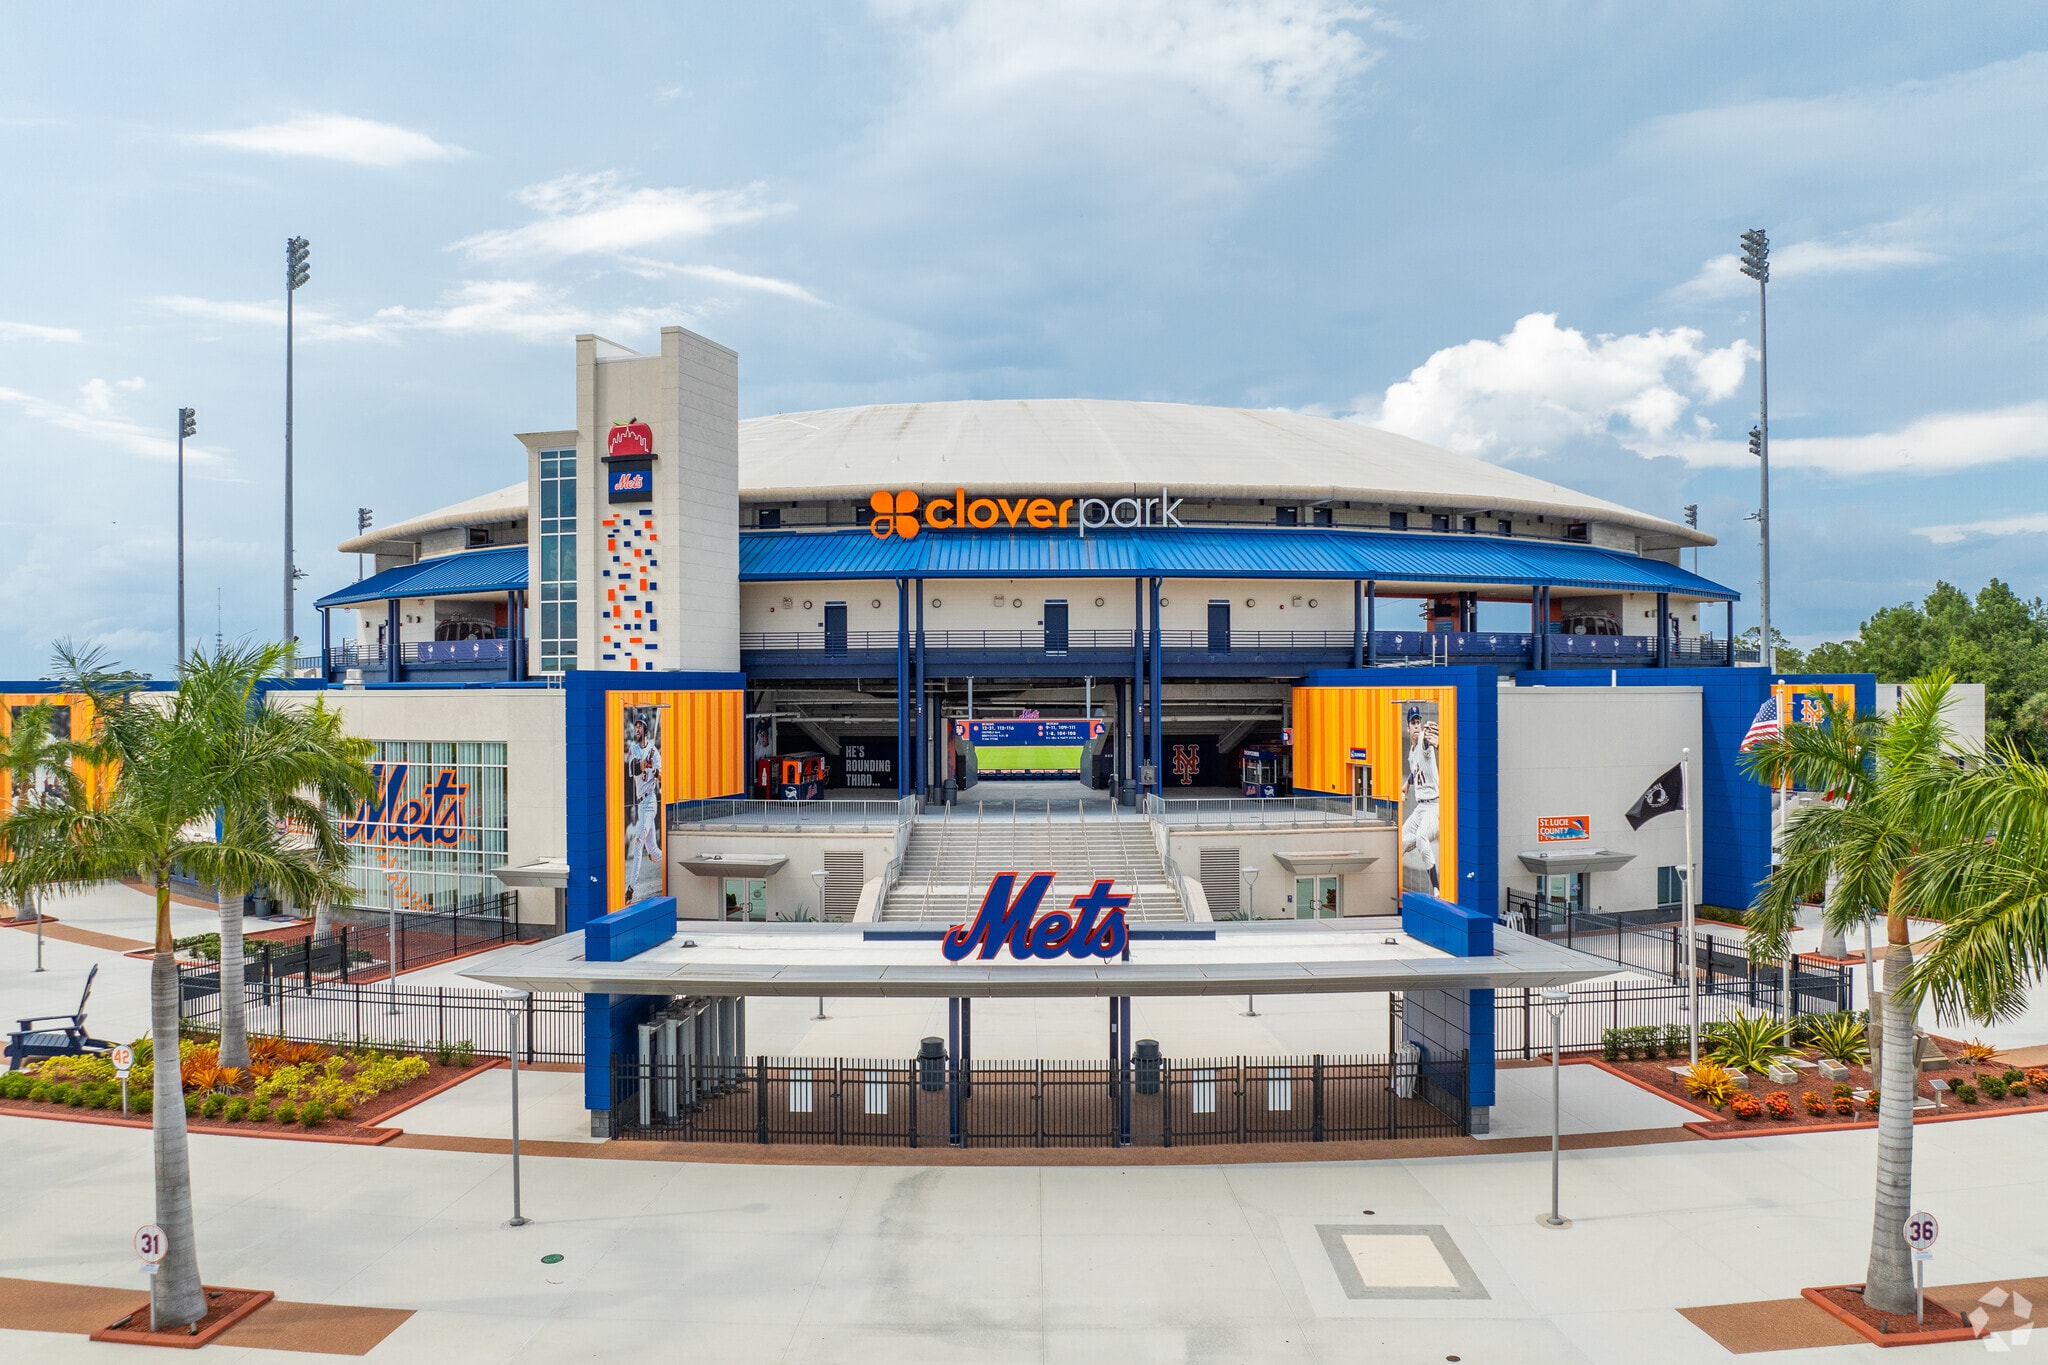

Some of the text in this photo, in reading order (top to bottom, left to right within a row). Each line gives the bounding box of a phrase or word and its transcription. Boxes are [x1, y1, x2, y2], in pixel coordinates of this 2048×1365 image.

[614, 473, 644, 491] Mets
[924, 487, 1185, 538] clover park
[846, 745, 865, 758] HE'S
[846, 759, 891, 772] ROUNDING
[846, 774, 881, 787] THIRD...
[338, 760, 470, 847] Mets
[1550, 818, 1569, 826] LUCIE
[941, 871, 1134, 962] Mets
[114, 1049, 130, 1065] 42
[1909, 1220, 1934, 1242] 36
[141, 1233, 159, 1255] 31
